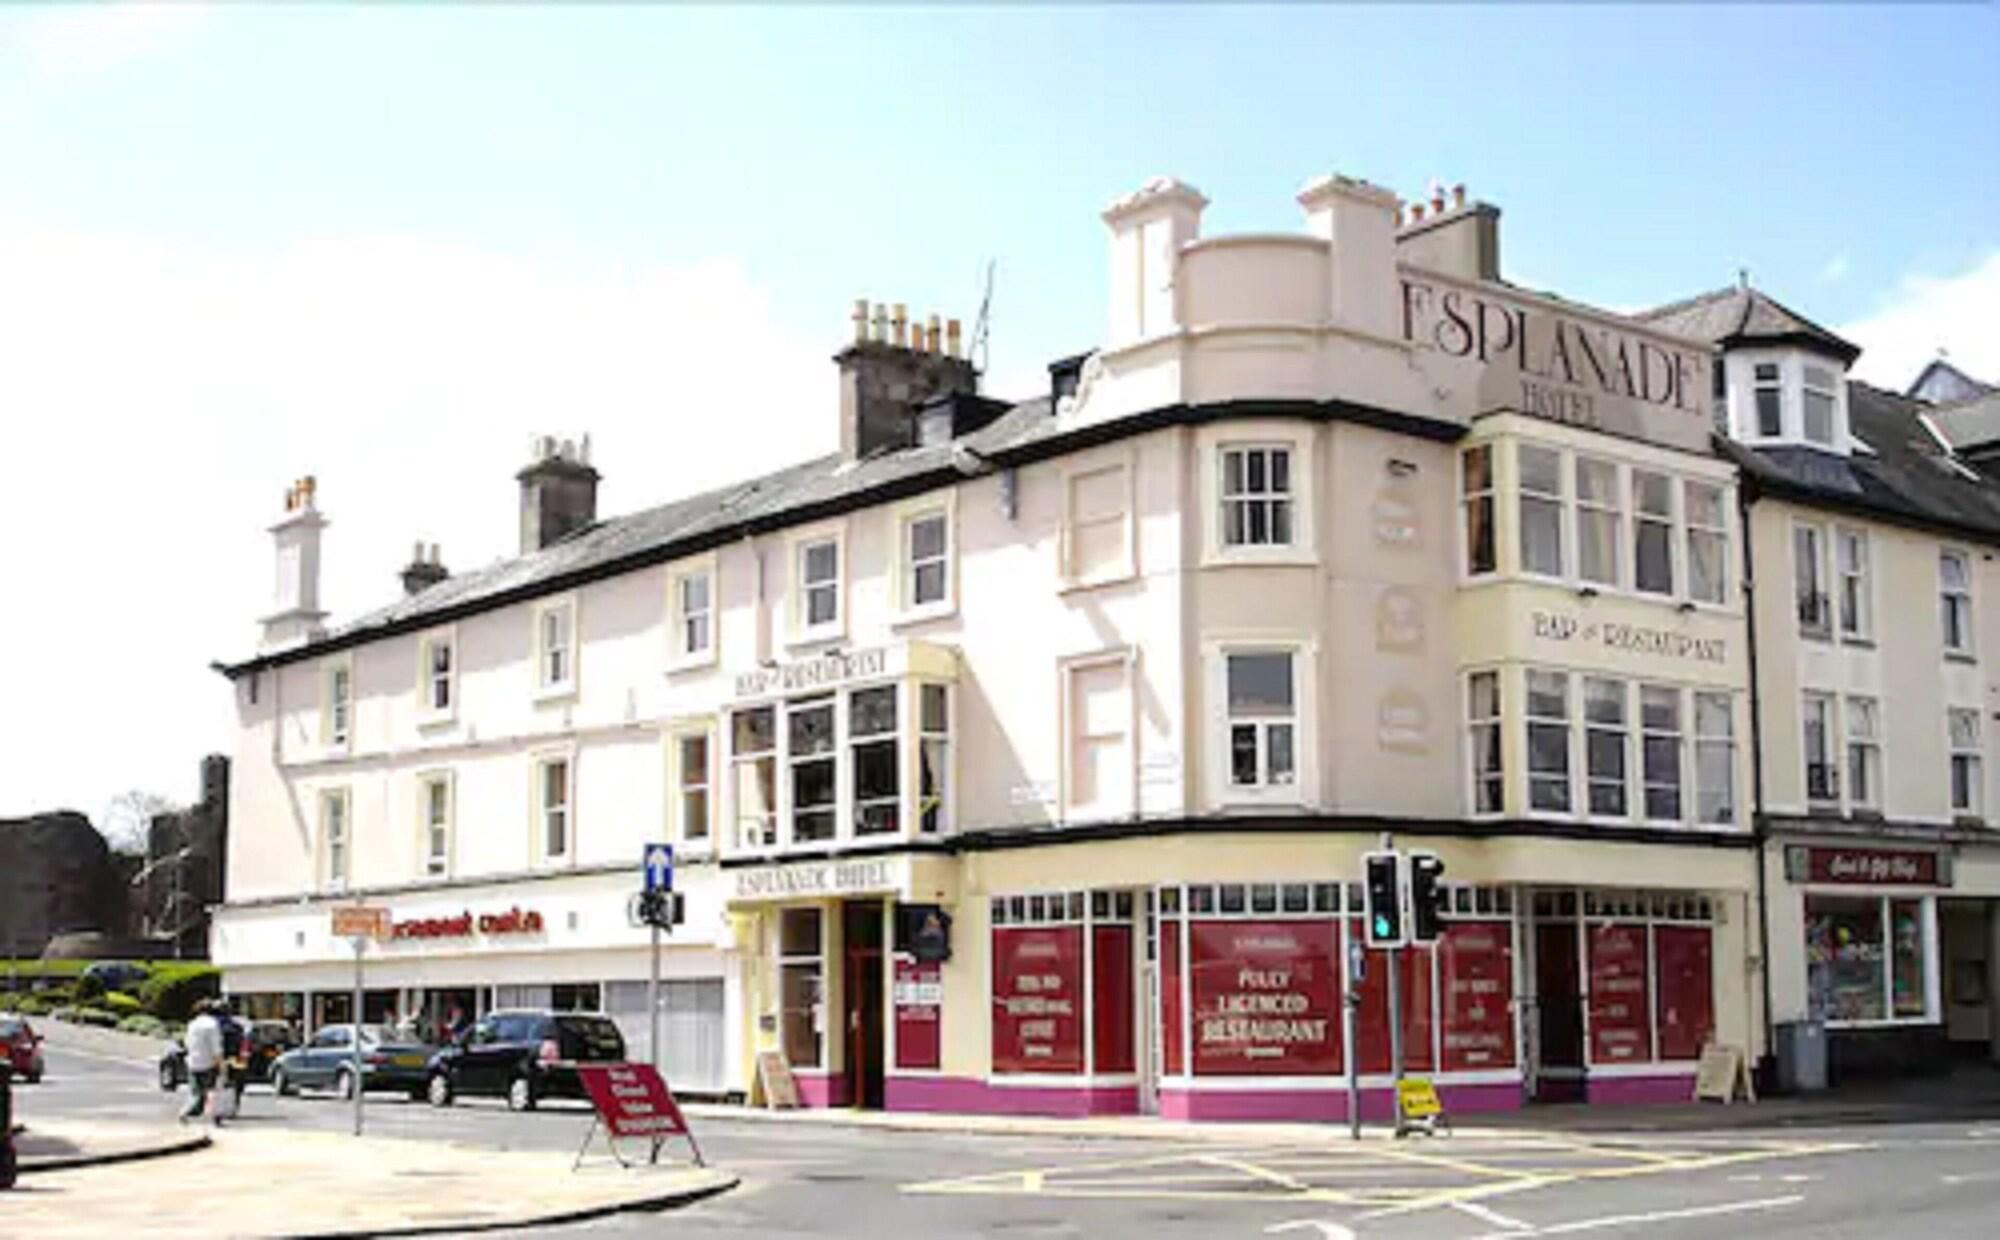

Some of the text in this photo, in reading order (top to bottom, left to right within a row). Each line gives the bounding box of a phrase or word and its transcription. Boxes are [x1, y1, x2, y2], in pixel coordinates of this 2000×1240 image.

[1400, 279, 1703, 416] ESPLANADE
[1519, 378, 1597, 426] HOTEL
[1532, 611, 1577, 641] BAR
[1603, 623, 1726, 664] RESTAURANT
[1238, 969, 1291, 989] FULLY
[1218, 994, 1310, 1016] LICENCED
[1201, 1018, 1329, 1044] RESTAURANT
